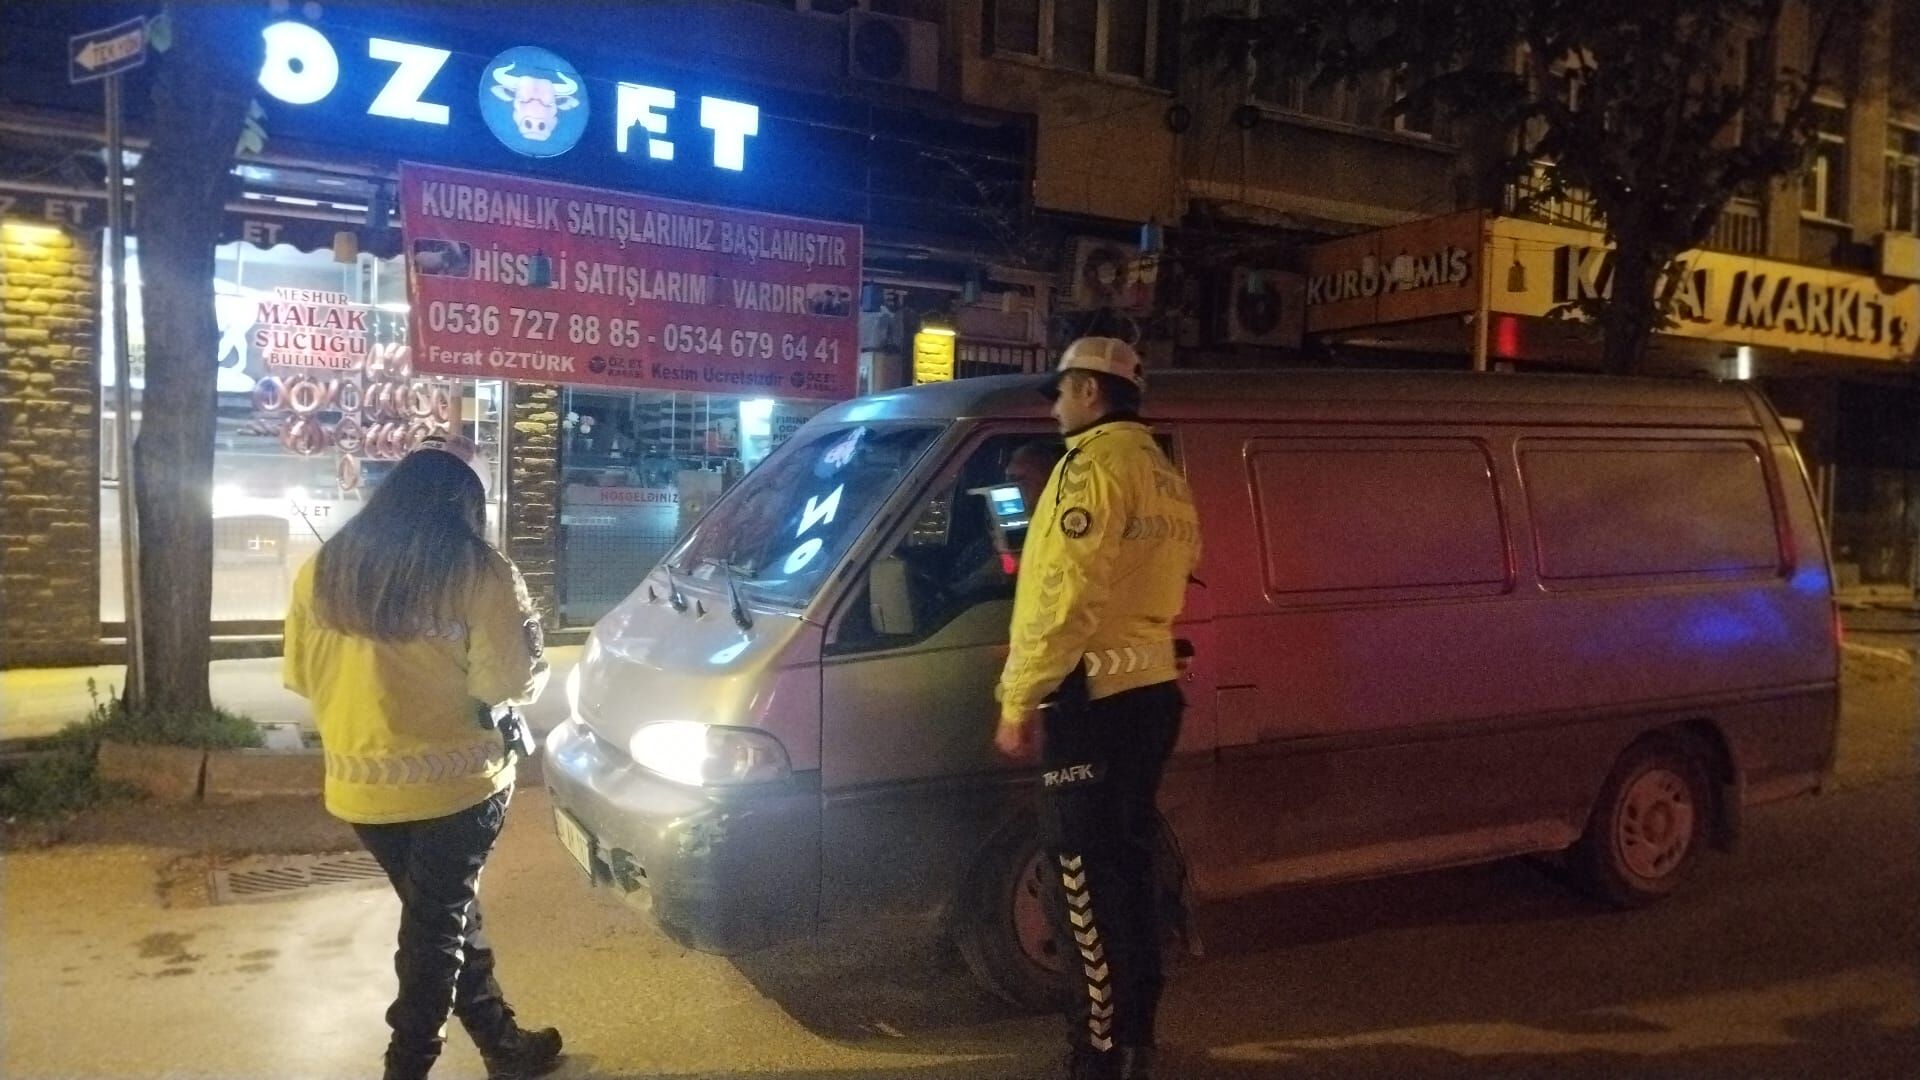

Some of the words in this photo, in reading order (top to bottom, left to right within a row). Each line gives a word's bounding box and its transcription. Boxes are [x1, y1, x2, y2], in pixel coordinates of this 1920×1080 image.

[616, 80, 760, 172] ET
[45, 199, 89, 225] ET
[421, 180, 561, 232] KURBANLIK
[566, 200, 715, 251] SATIŞLARIMIZ
[721, 220, 847, 273] BAŞLAMIŞTIR
[243, 220, 283, 245] ET
[474, 243, 567, 291] HİSSLİ
[732, 279, 807, 315] VARDIR
[256, 302, 368, 331] MALAK
[428, 301, 500, 337] 0536
[509, 306, 560, 341] 727
[568, 313, 601, 345] 88
[609, 318, 640, 349] 85
[663, 323, 724, 356] 0534
[730, 329, 774, 360] 679
[781, 333, 809, 362] 64
[814, 336, 840, 365] 41
[269, 352, 352, 369] BULUNUR
[429, 345, 483, 366] Ferat
[488, 347, 575, 374] ÖZTÜRK
[651, 362, 698, 382] Kesim
